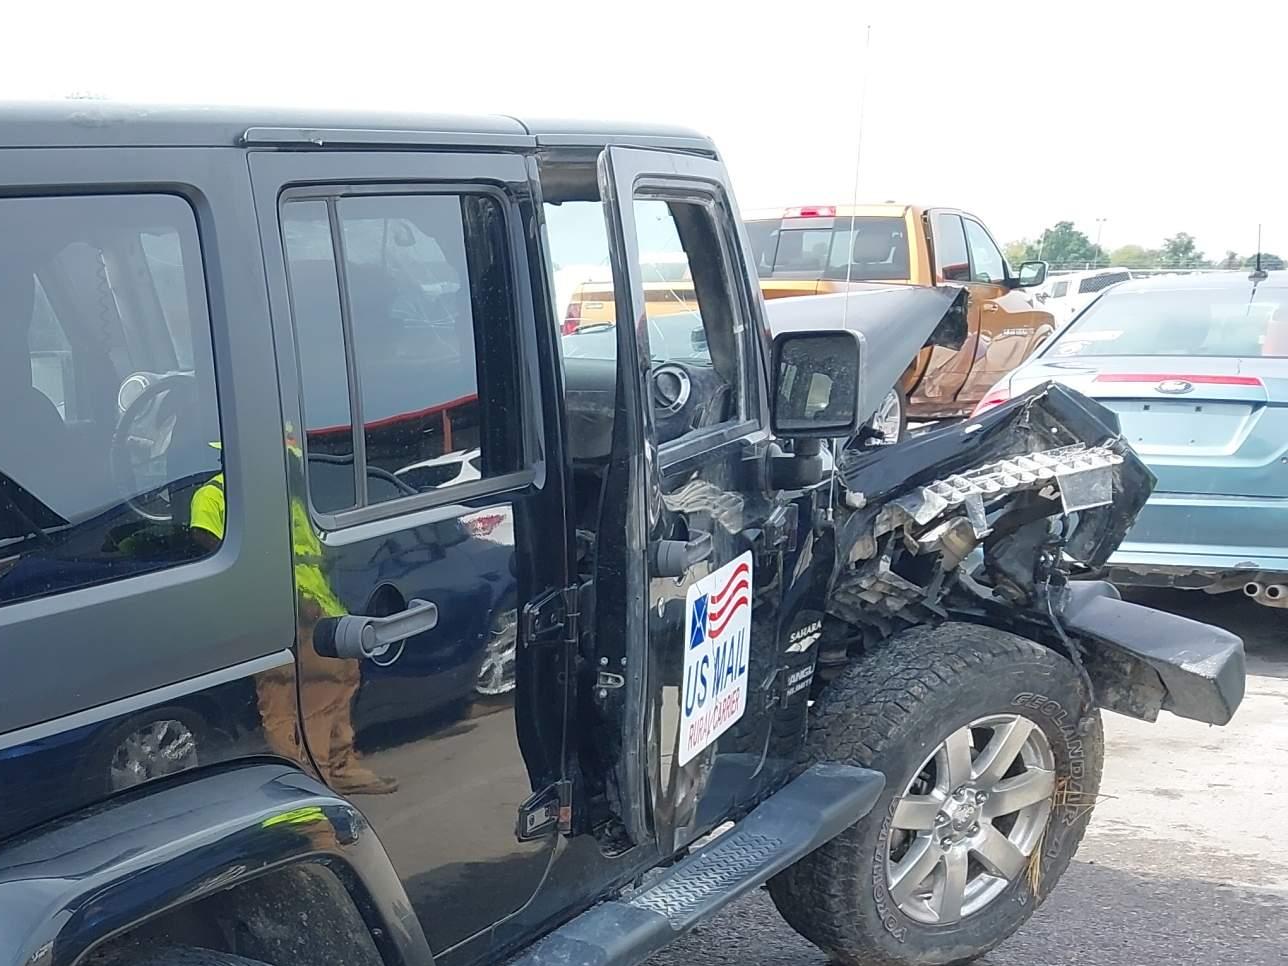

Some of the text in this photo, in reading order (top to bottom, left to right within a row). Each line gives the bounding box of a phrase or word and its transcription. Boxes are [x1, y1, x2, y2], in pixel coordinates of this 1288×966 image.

[789, 620, 822, 643] SAHARA
[685, 627, 746, 717] US MAIL
[688, 687, 740, 750] RURAL CARRIER
